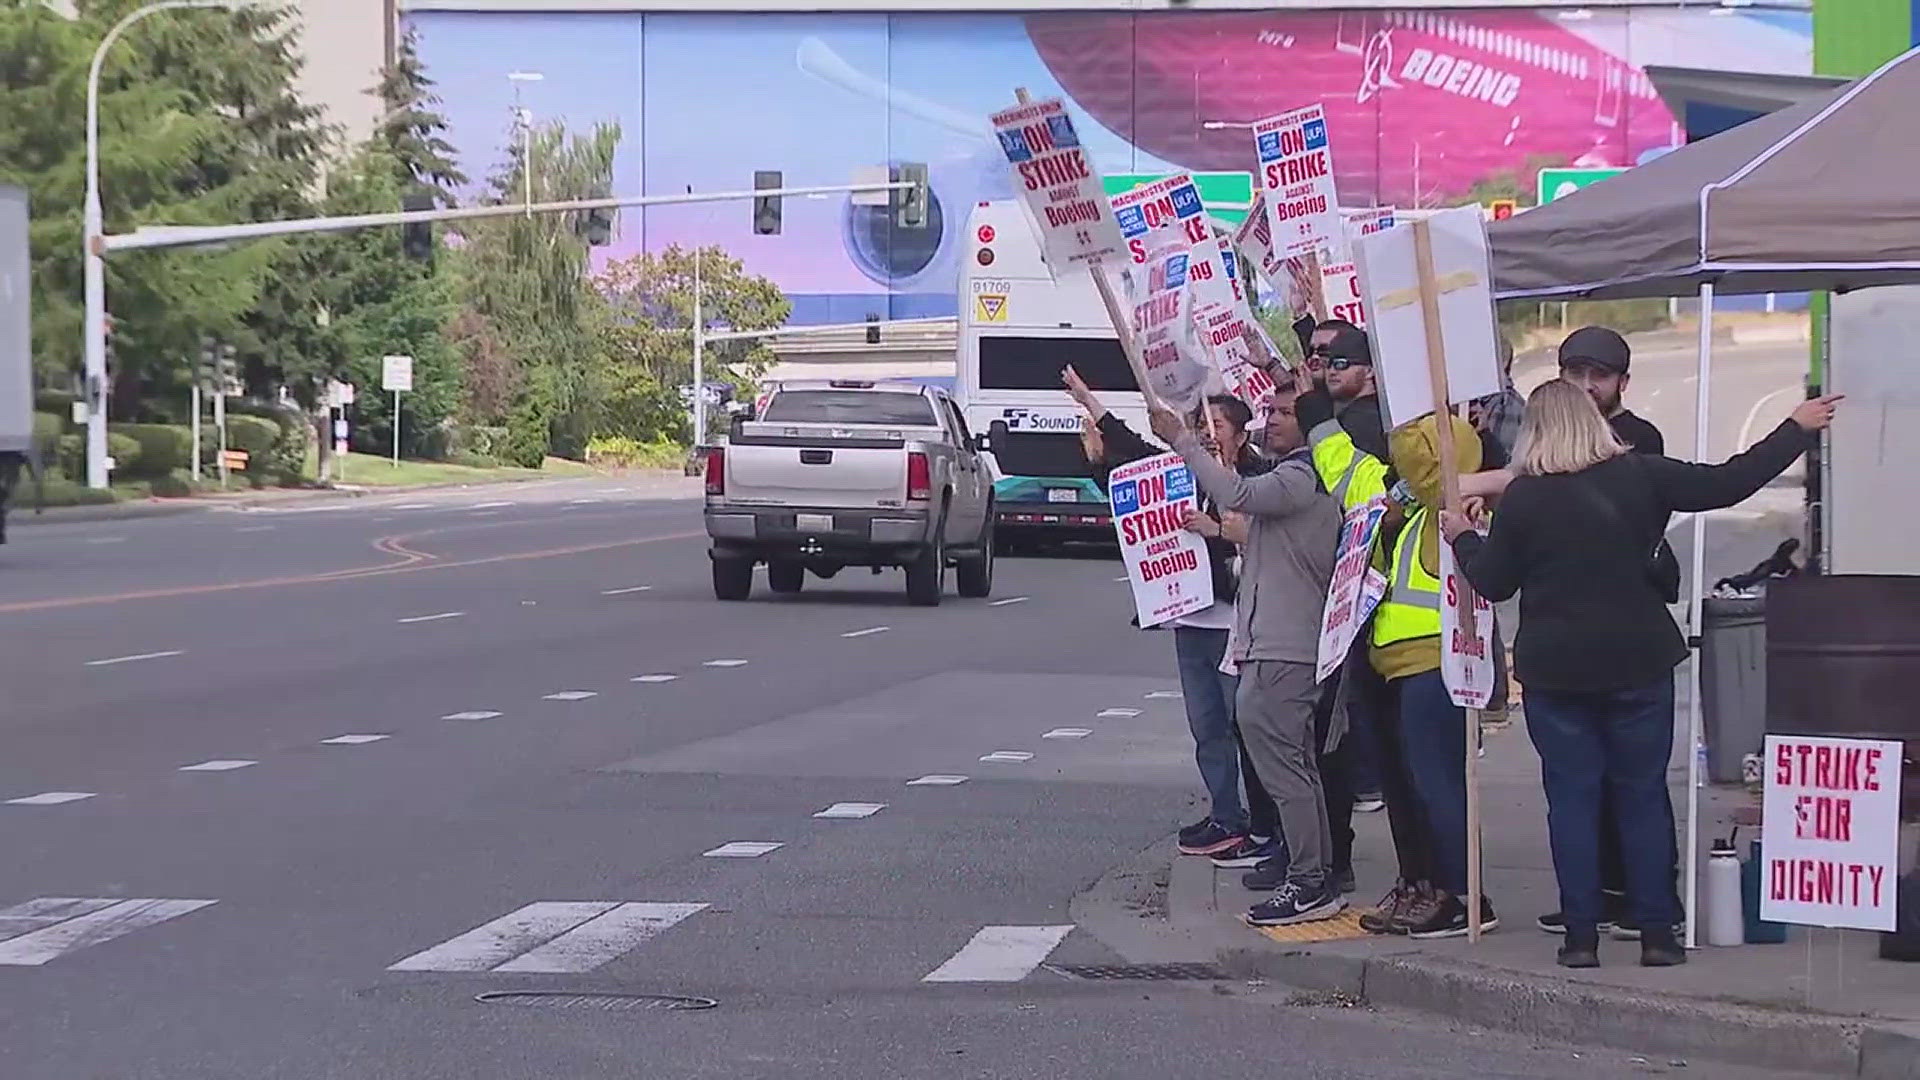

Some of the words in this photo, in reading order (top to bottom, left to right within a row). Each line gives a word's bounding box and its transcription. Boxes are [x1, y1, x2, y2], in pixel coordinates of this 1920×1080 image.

[1400, 48, 1521, 107] BOEING
[1023, 122, 1055, 154] ON
[1281, 129, 1304, 156] ON
[1018, 150, 1090, 190] STRIKE
[1266, 151, 1328, 189] STRIKE
[1111, 183, 1163, 208] MACHINISTS
[1164, 174, 1190, 190] UNION
[1044, 199, 1101, 228] Boeing
[1143, 196, 1175, 228] ON
[1277, 195, 1327, 221] Boeing
[1323, 264, 1355, 276] MACHIN
[973, 281, 1010, 293] 91709
[1113, 486, 1136, 505] ULP!
[1138, 475, 1166, 506] ON
[1147, 536, 1181, 556] AGAINST
[1139, 550, 1198, 582] Boeing
[1777, 744, 1882, 791] STRIKE
[1795, 796, 1851, 841] FOR
[1771, 859, 1884, 907] DIGNITY
